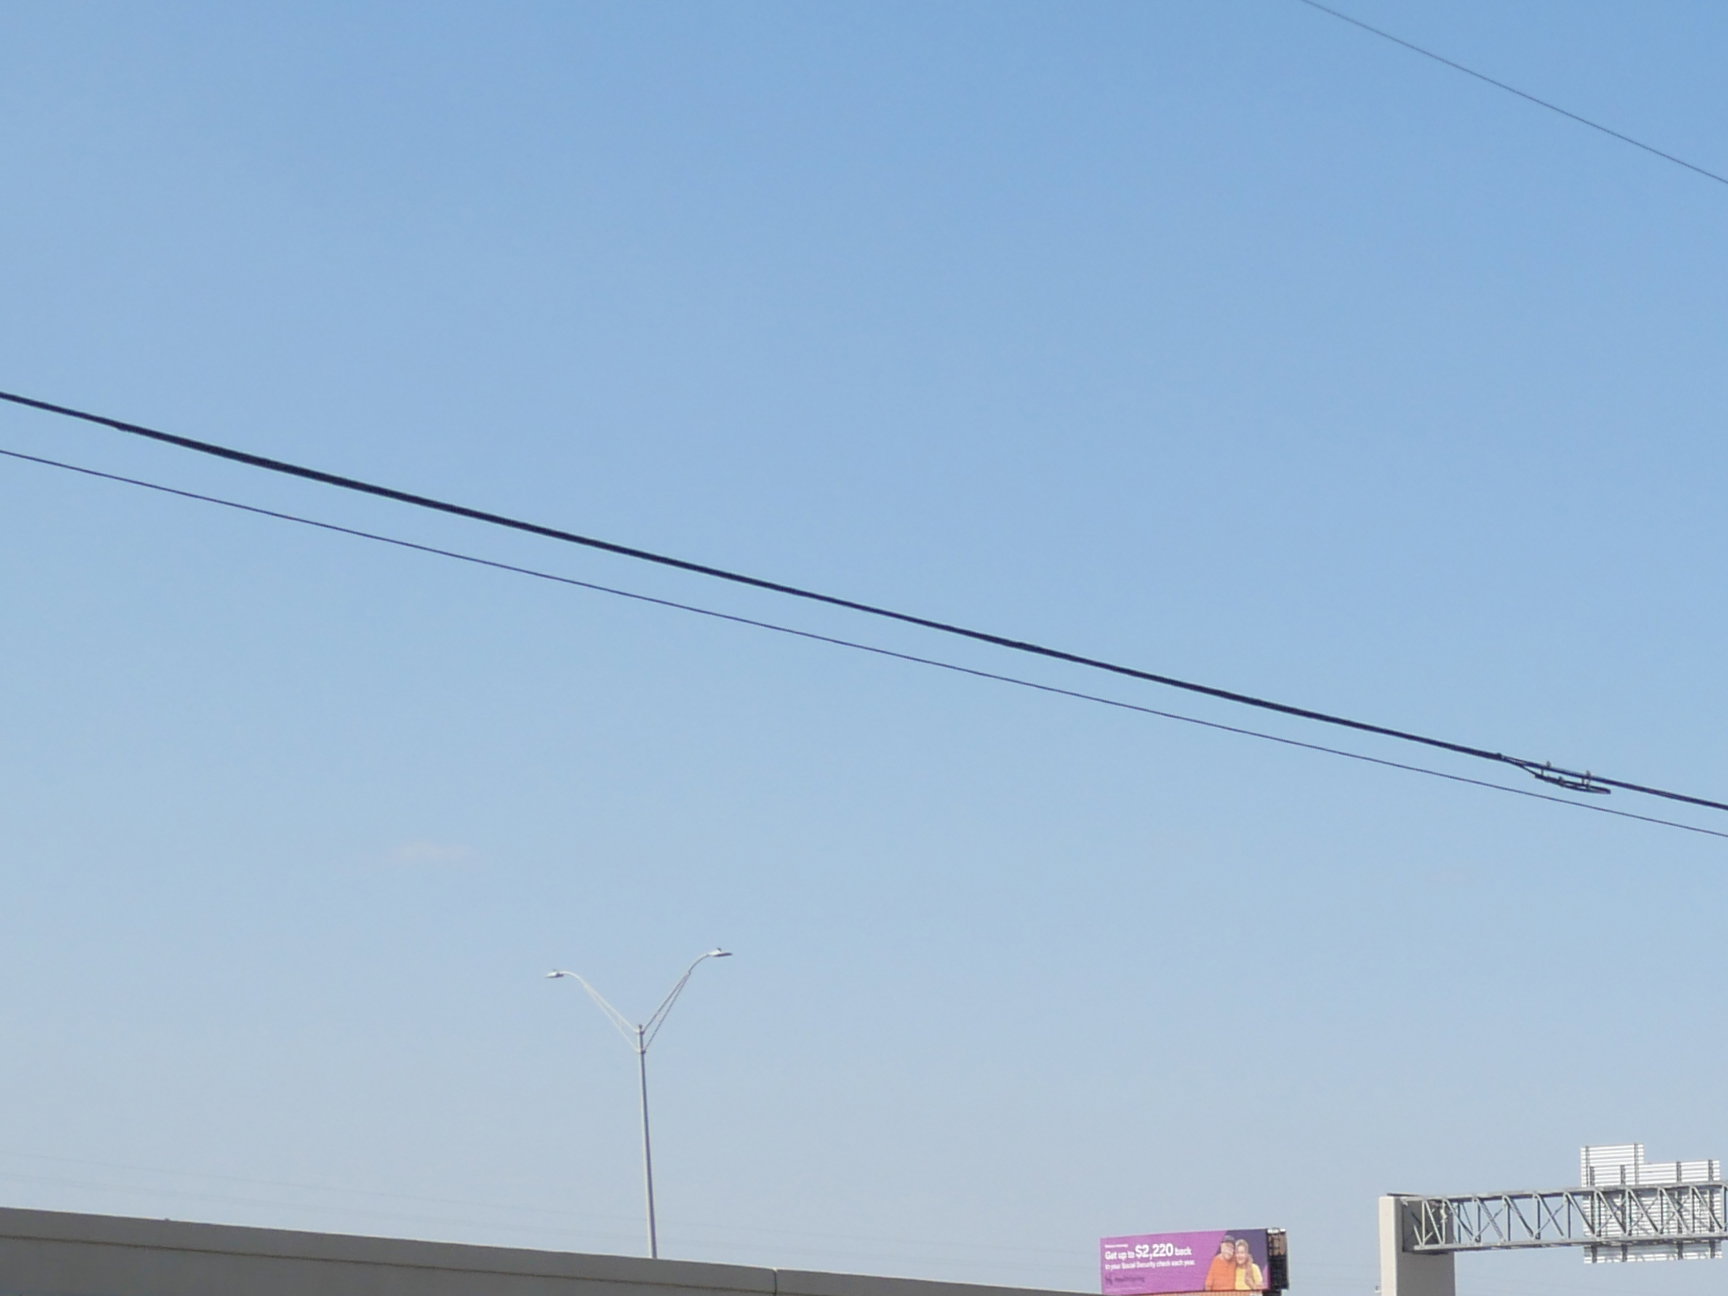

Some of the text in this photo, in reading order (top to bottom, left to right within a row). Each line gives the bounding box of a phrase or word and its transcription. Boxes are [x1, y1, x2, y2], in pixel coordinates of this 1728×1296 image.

[1104, 1251, 1117, 1260] Get
[1118, 1252, 1127, 1261] up
[1135, 1243, 1174, 1260] $2,220
